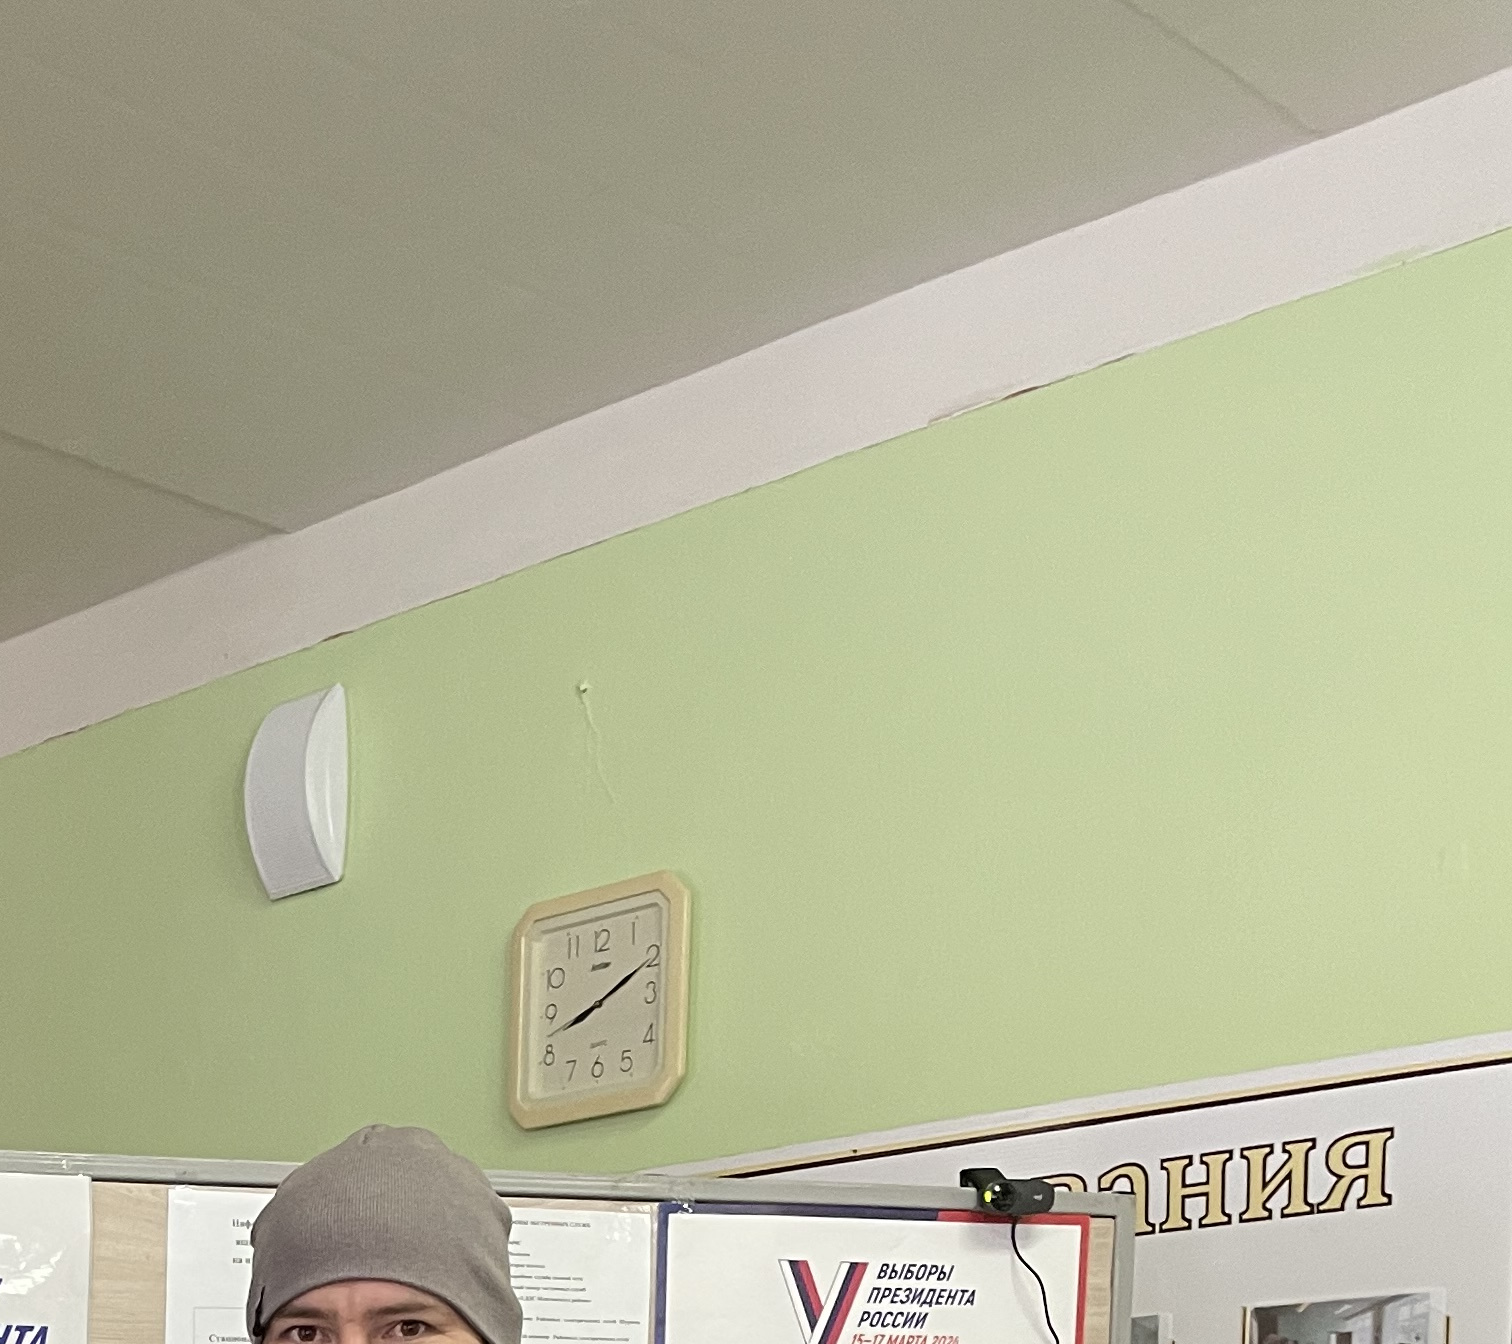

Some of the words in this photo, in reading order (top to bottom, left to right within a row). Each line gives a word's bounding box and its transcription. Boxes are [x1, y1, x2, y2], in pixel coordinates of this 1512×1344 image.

[567, 933, 579, 959] 11
[594, 928, 611, 952] 12
[645, 944, 660, 968] 2
[547, 968, 565, 991] 10
[644, 981, 657, 1004] 3
[545, 1004, 557, 1024] 9
[642, 1023, 655, 1043] 4
[543, 1044, 555, 1066] 8
[620, 1050, 633, 1072] 5
[566, 1060, 577, 1081] 7
[592, 1055, 604, 1078] 6
[877, 1263, 955, 1281] ВЫБОРЫ
[867, 1287, 976, 1307] ПРЕЗИДЕНТА
[857, 1311, 929, 1329] РОССИИ
